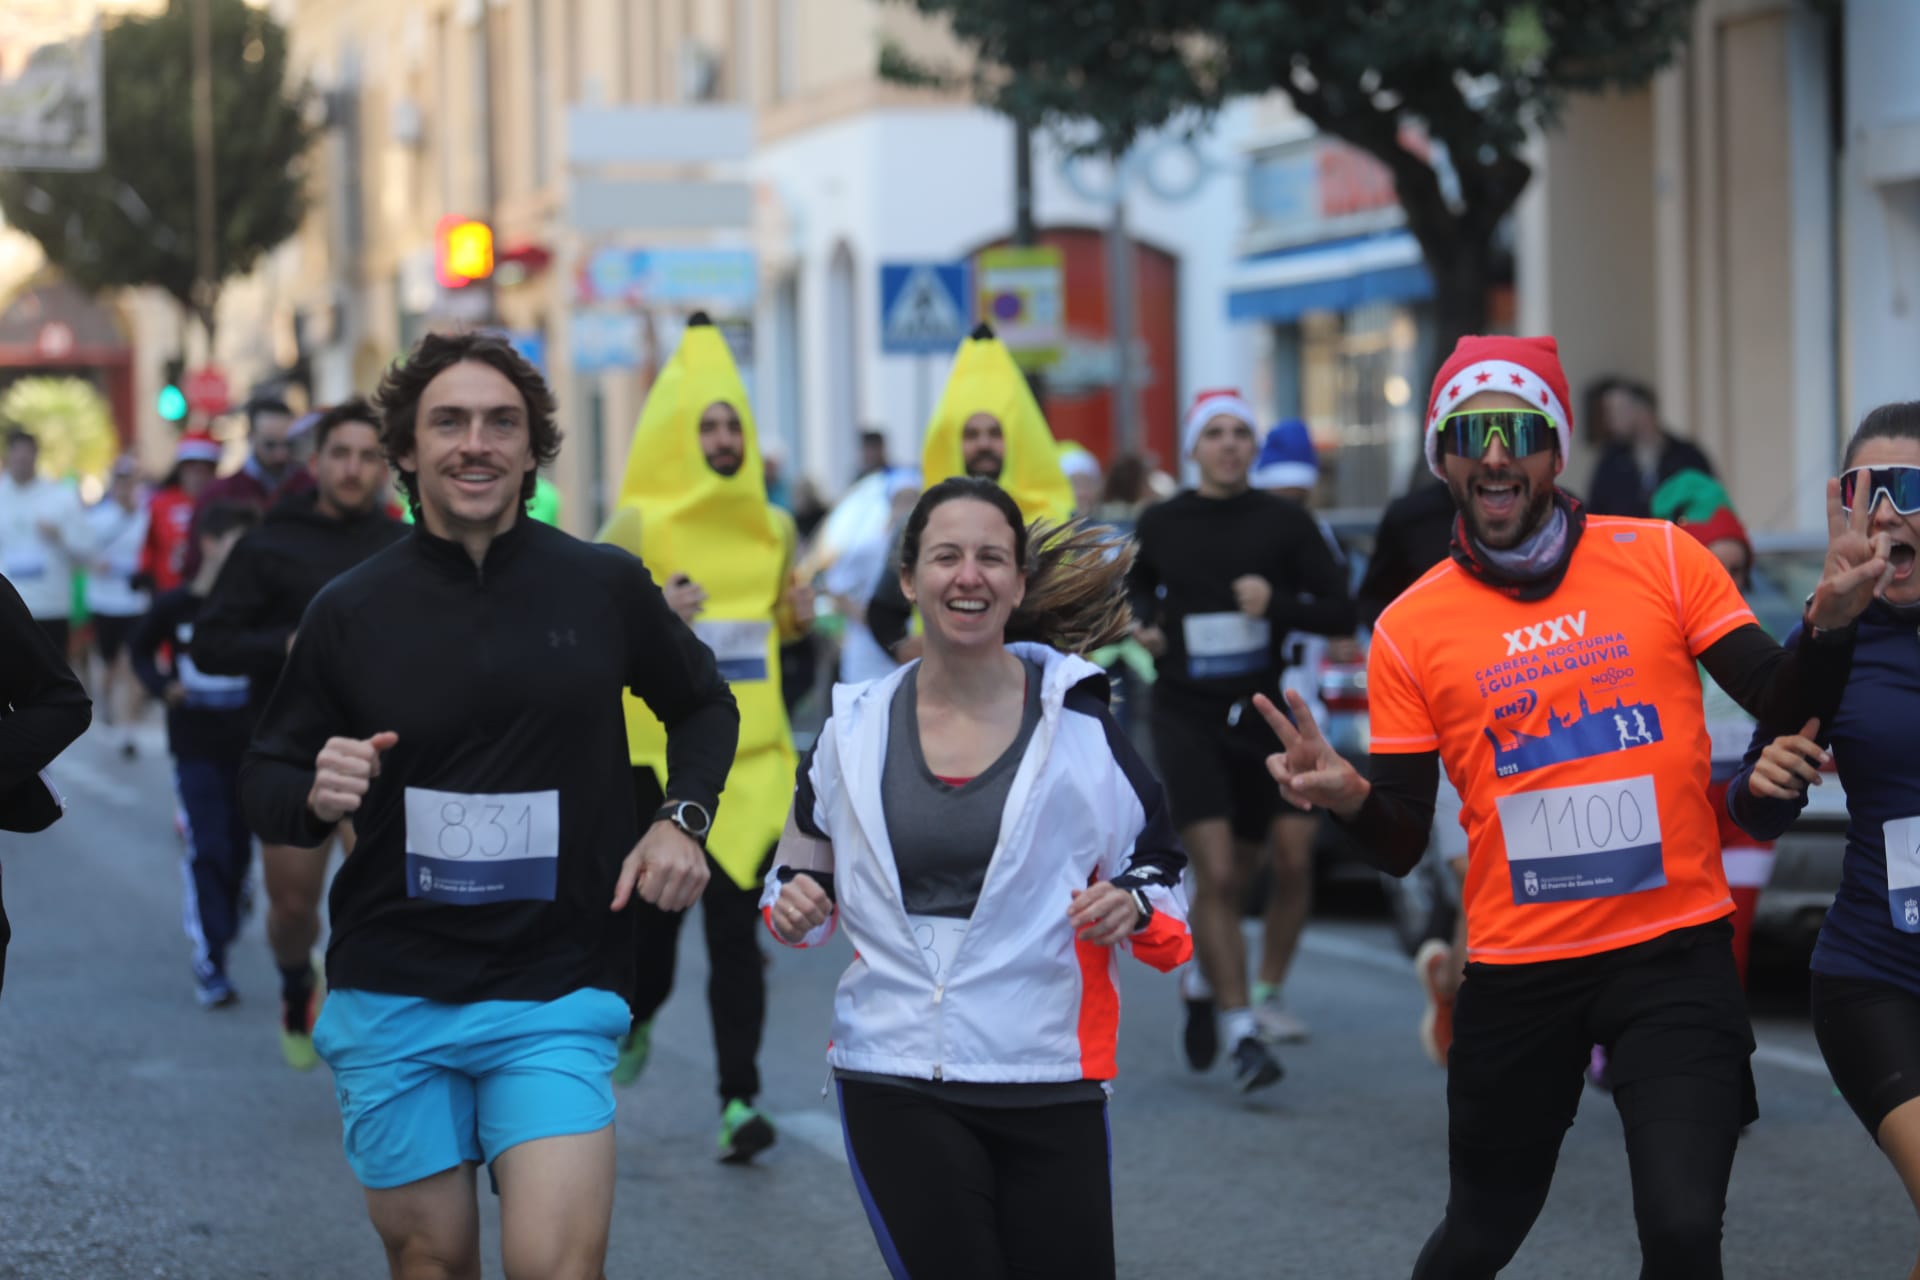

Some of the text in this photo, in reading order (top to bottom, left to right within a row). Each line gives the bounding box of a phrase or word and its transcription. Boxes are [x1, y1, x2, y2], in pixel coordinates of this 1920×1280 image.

[1475, 632, 1625, 681] CARRERA NOCTURNA
[1502, 610, 1586, 656] XXXV
[1488, 644, 1629, 693] GUADALQUIVIR
[437, 801, 532, 859] 831
[1530, 789, 1643, 852] 1100
